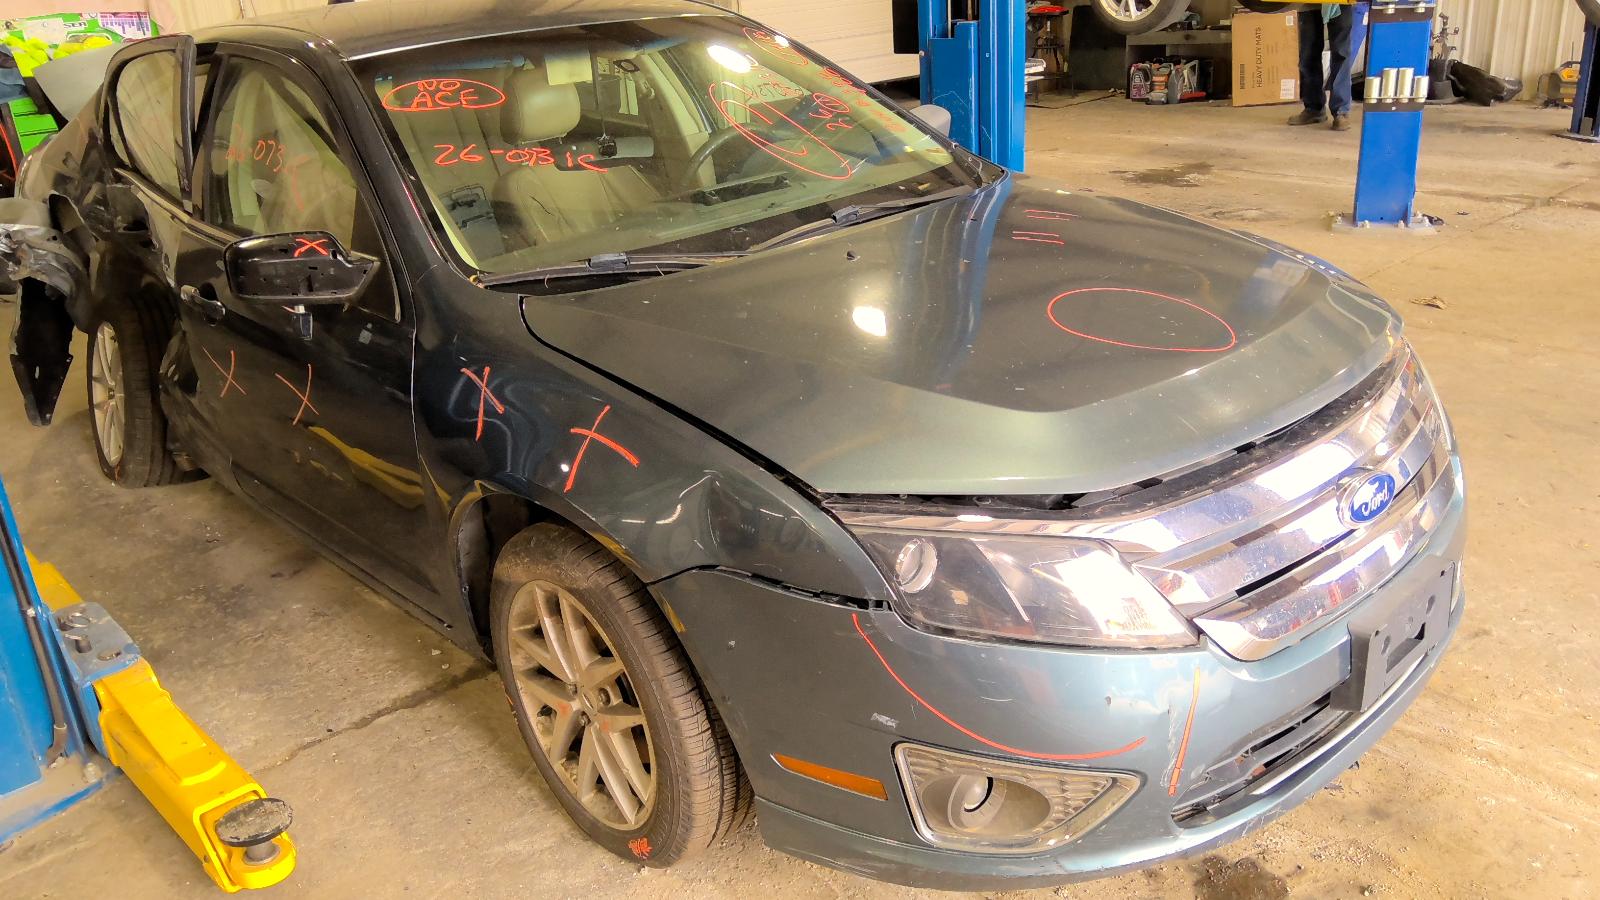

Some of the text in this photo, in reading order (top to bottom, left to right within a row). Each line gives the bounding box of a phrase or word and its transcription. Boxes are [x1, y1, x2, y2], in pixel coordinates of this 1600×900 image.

[1255, 26, 1263, 45] MATS
[418, 80, 461, 91] NO
[1358, 481, 1389, 516] Ford
